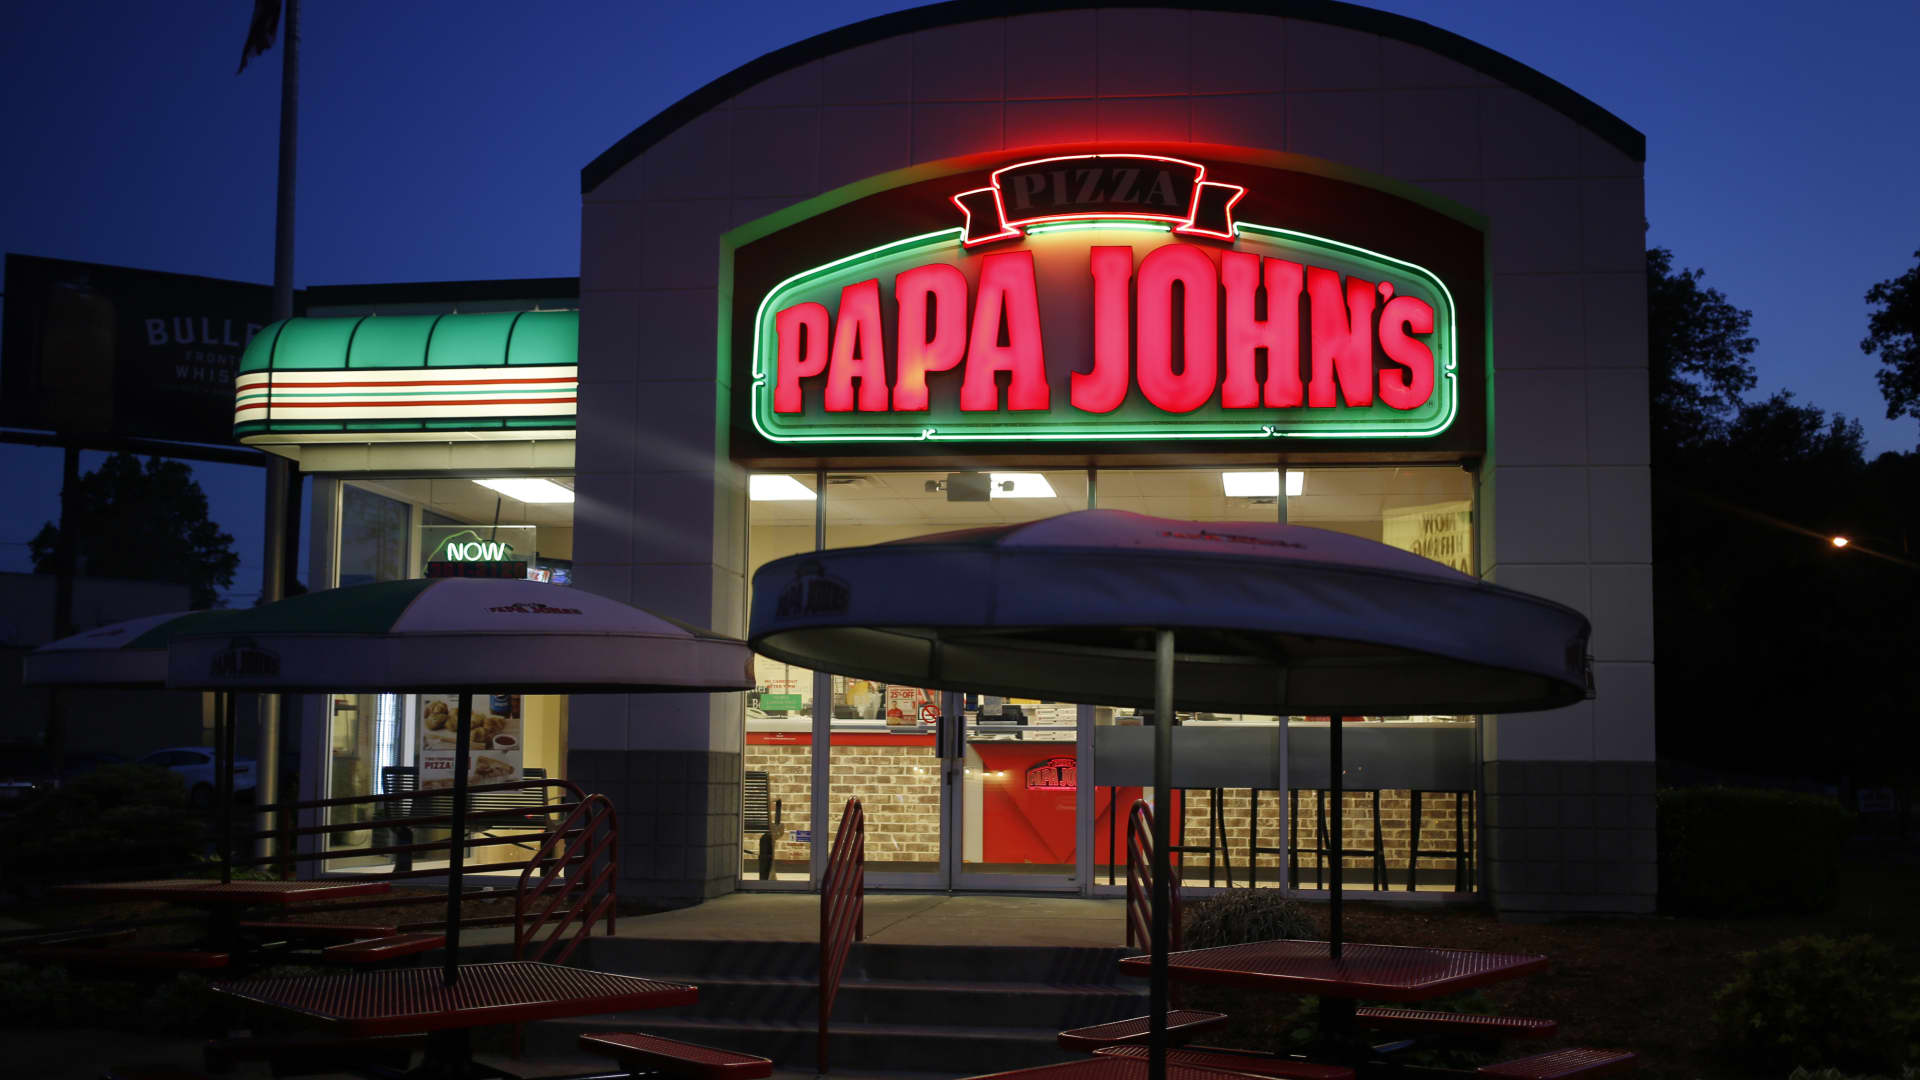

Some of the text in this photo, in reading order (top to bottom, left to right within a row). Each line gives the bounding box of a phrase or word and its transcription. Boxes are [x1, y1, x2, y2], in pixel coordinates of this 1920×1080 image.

[1008, 168, 1181, 211] PIZZA
[774, 243, 1434, 414] PAPA JOHN'S
[175, 364, 240, 383] WHIS
[447, 542, 507, 562] NOW
[424, 761, 451, 769] PIZZA
